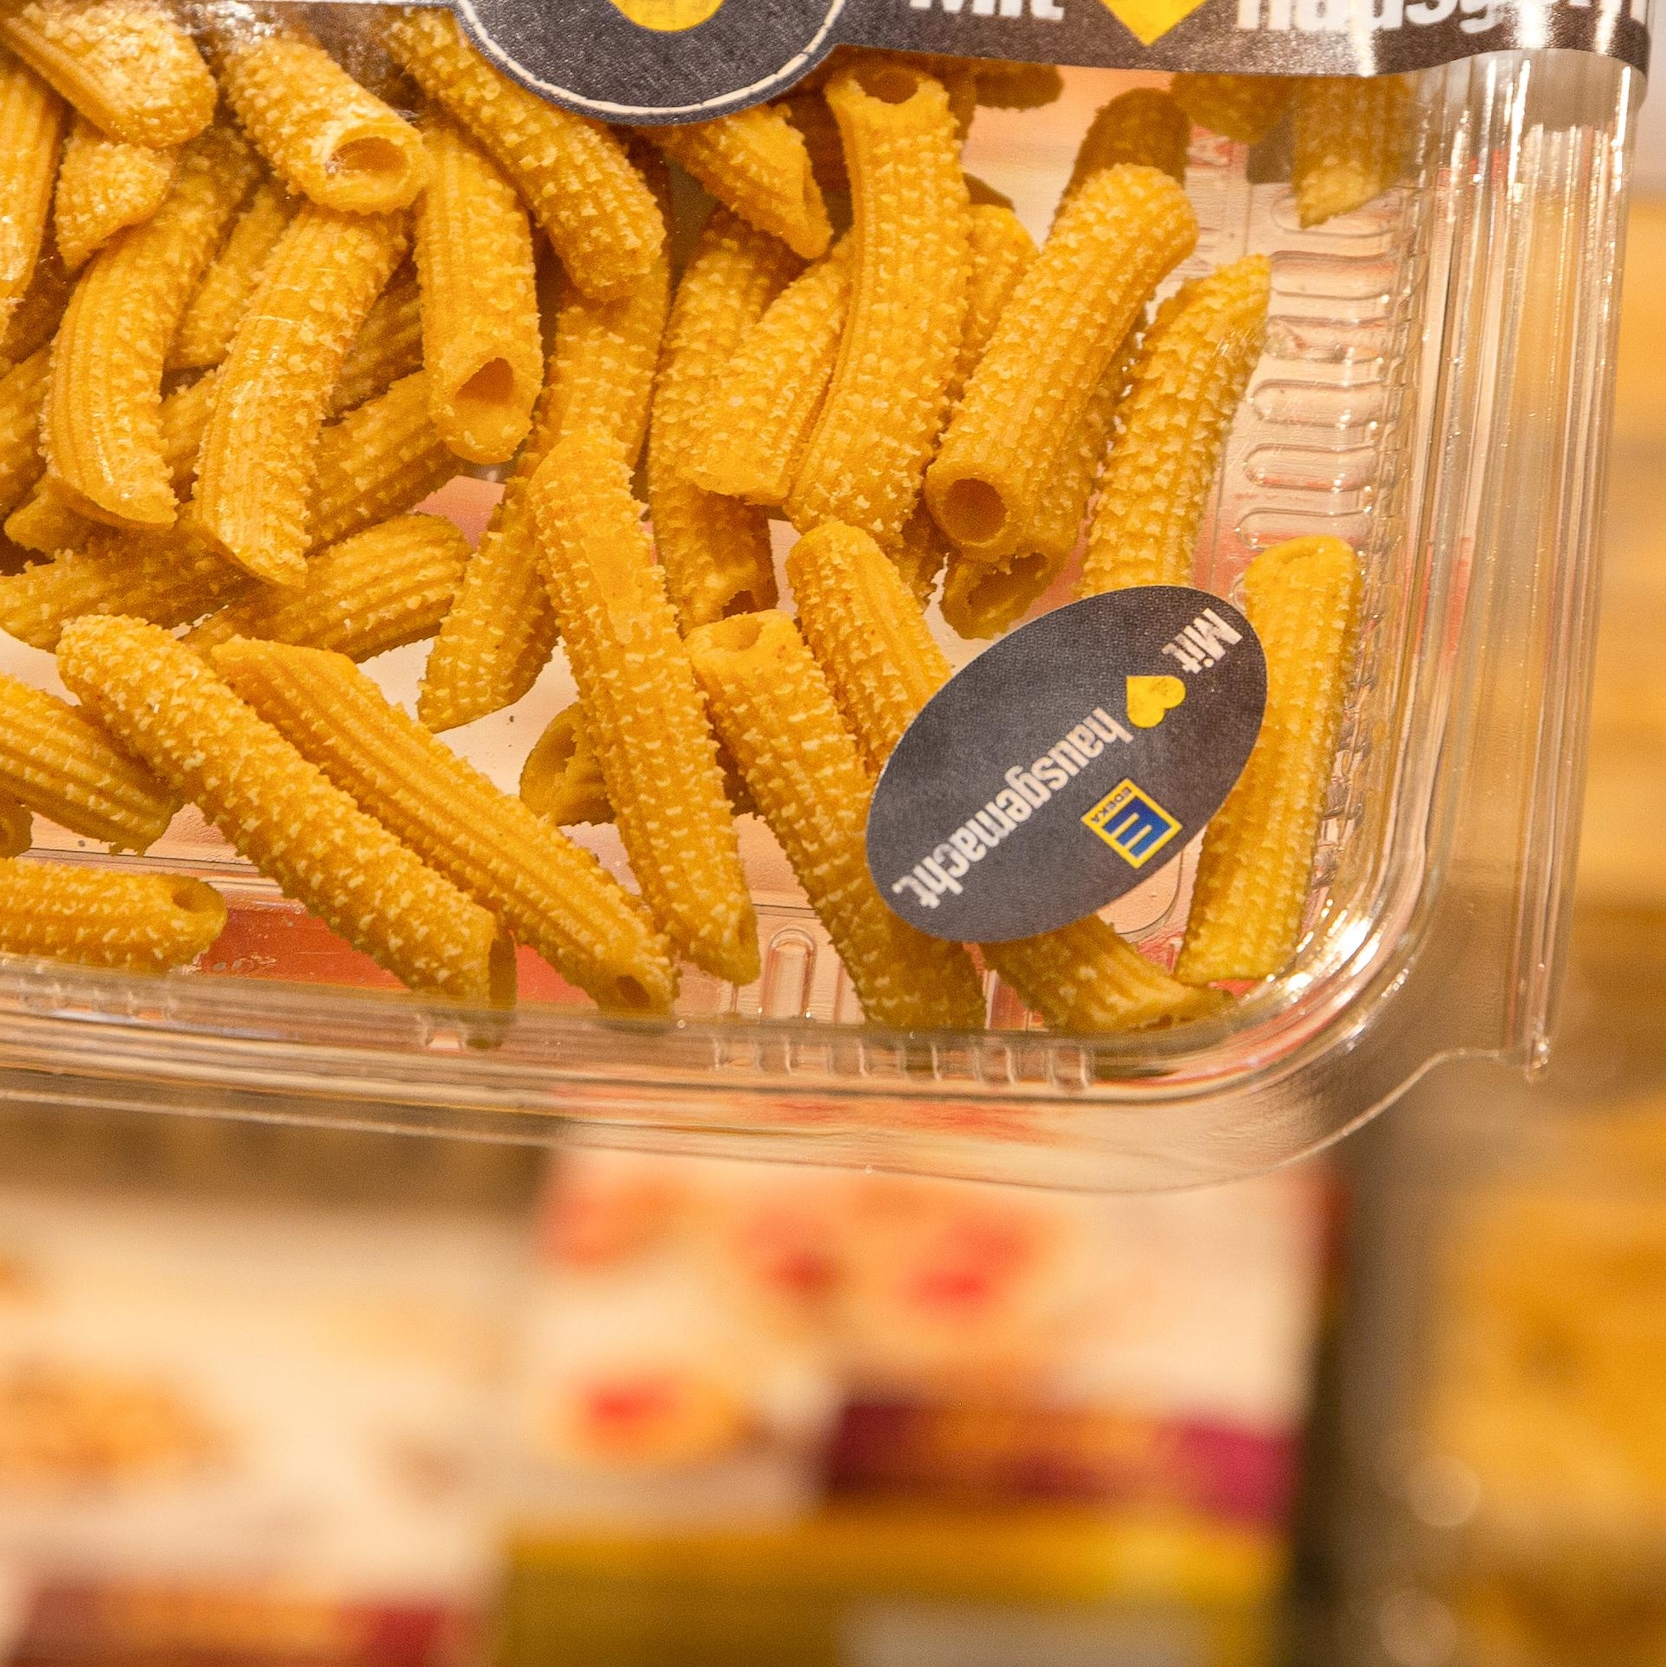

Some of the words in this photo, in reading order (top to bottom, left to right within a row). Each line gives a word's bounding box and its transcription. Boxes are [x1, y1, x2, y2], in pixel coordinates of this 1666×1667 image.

[1161, 607, 1244, 675] Mit
[890, 706, 1135, 909] hausgemacht.
[1090, 785, 1133, 824] EDEKA
